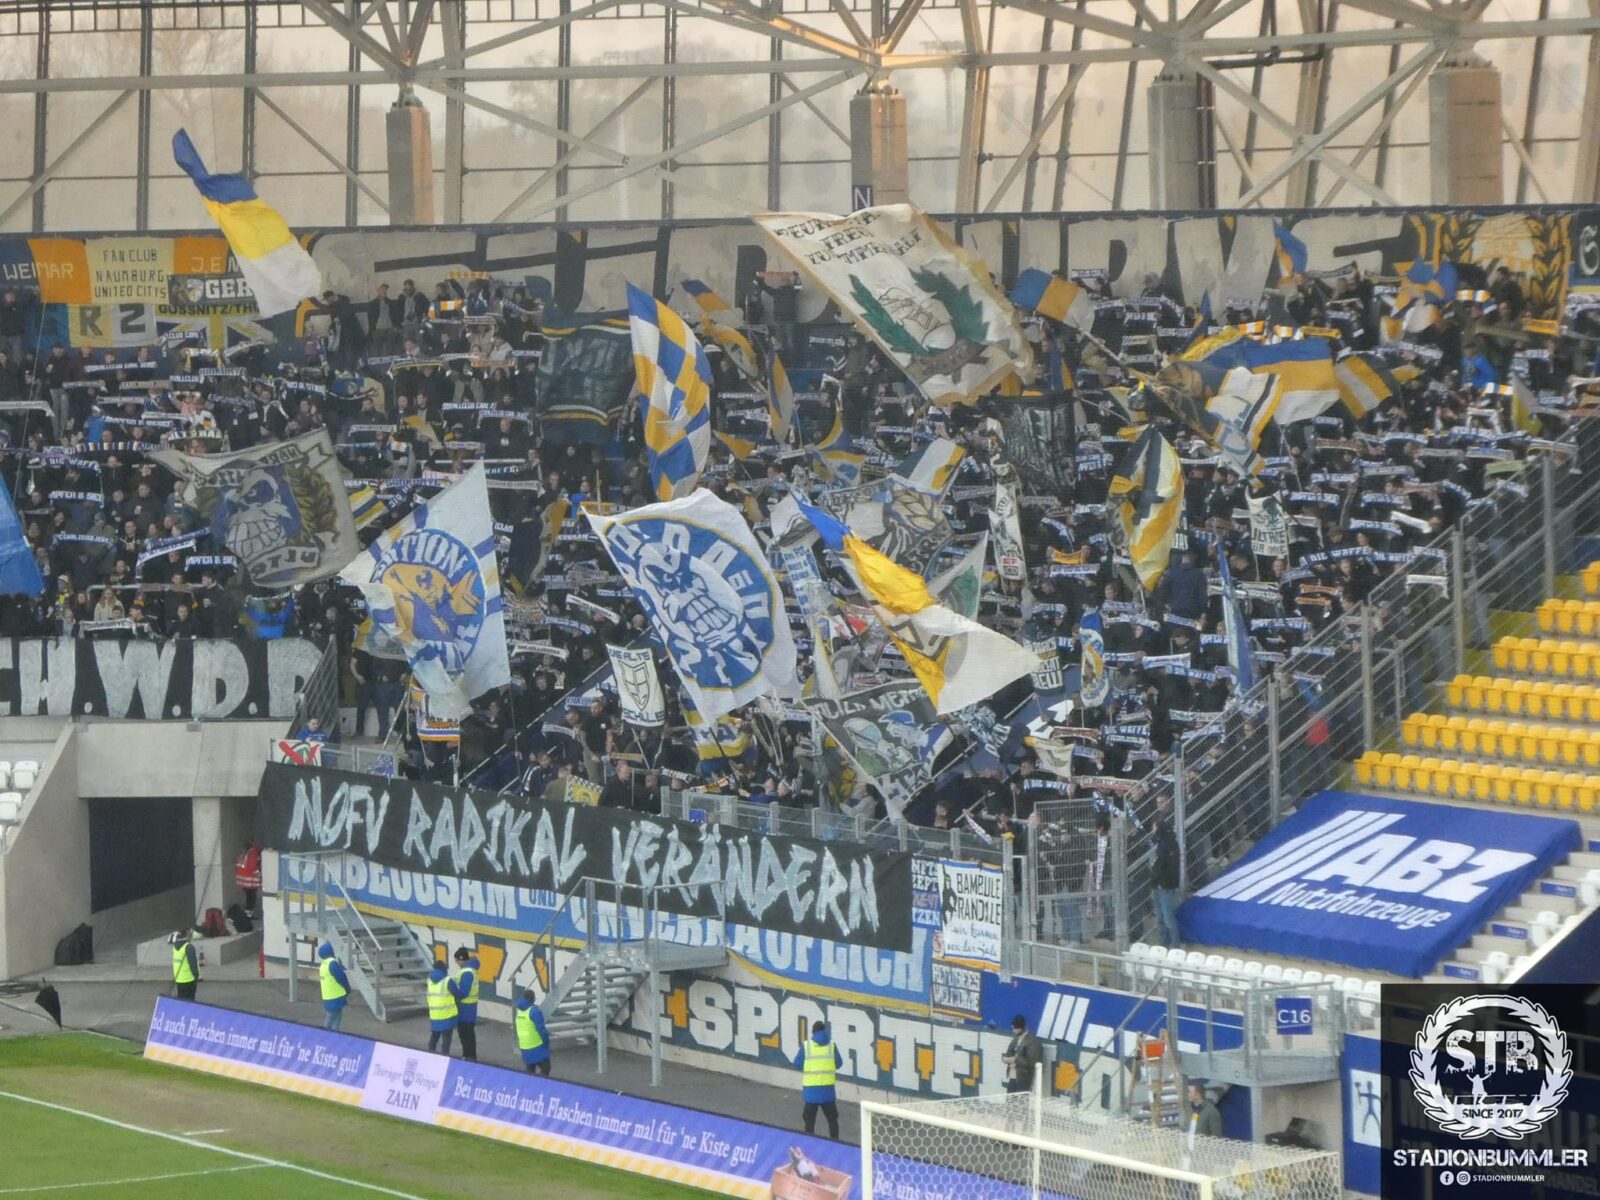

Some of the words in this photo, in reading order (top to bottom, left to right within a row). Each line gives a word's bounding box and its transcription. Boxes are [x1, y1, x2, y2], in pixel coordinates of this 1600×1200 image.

[103, 250, 125, 262] FAN
[129, 249, 157, 261] CLUB
[3, 262, 74, 280] WEIMAR
[96, 269, 164, 282] NAUMBURG
[95, 286, 132, 298] UNITED
[136, 285, 166, 299] CITYS
[205, 278, 254, 299] GER
[288, 776, 390, 854] NOFV
[403, 787, 587, 890] RADIKAL
[612, 820, 880, 936] VERÄNDERN
[1301, 833, 1537, 903] ABZ
[956, 872, 1000, 899] BAMBULE
[957, 897, 1000, 925] RANDALE
[1257, 881, 1453, 931] Nutzfahrzeuge
[1277, 1008, 1312, 1025] C16
[164, 1016, 186, 1036] auch
[187, 1018, 226, 1045] Flaschen
[227, 1027, 258, 1050] immer
[258, 1034, 278, 1055] mal
[277, 1036, 294, 1058] für
[312, 1044, 338, 1069] Kiste
[337, 1053, 362, 1076] gut!
[386, 1088, 421, 1111] ZAHN
[454, 1076, 472, 1099] Bei
[474, 1087, 493, 1104] uns
[495, 1087, 519, 1109] sind
[519, 1094, 545, 1116] auch
[547, 1096, 593, 1126] Flaschen
[595, 1108, 633, 1136] immer
[633, 1118, 656, 1141] mal
[656, 1120, 678, 1146] für
[698, 1130, 731, 1158] Kiste
[730, 1143, 758, 1167] gut!
